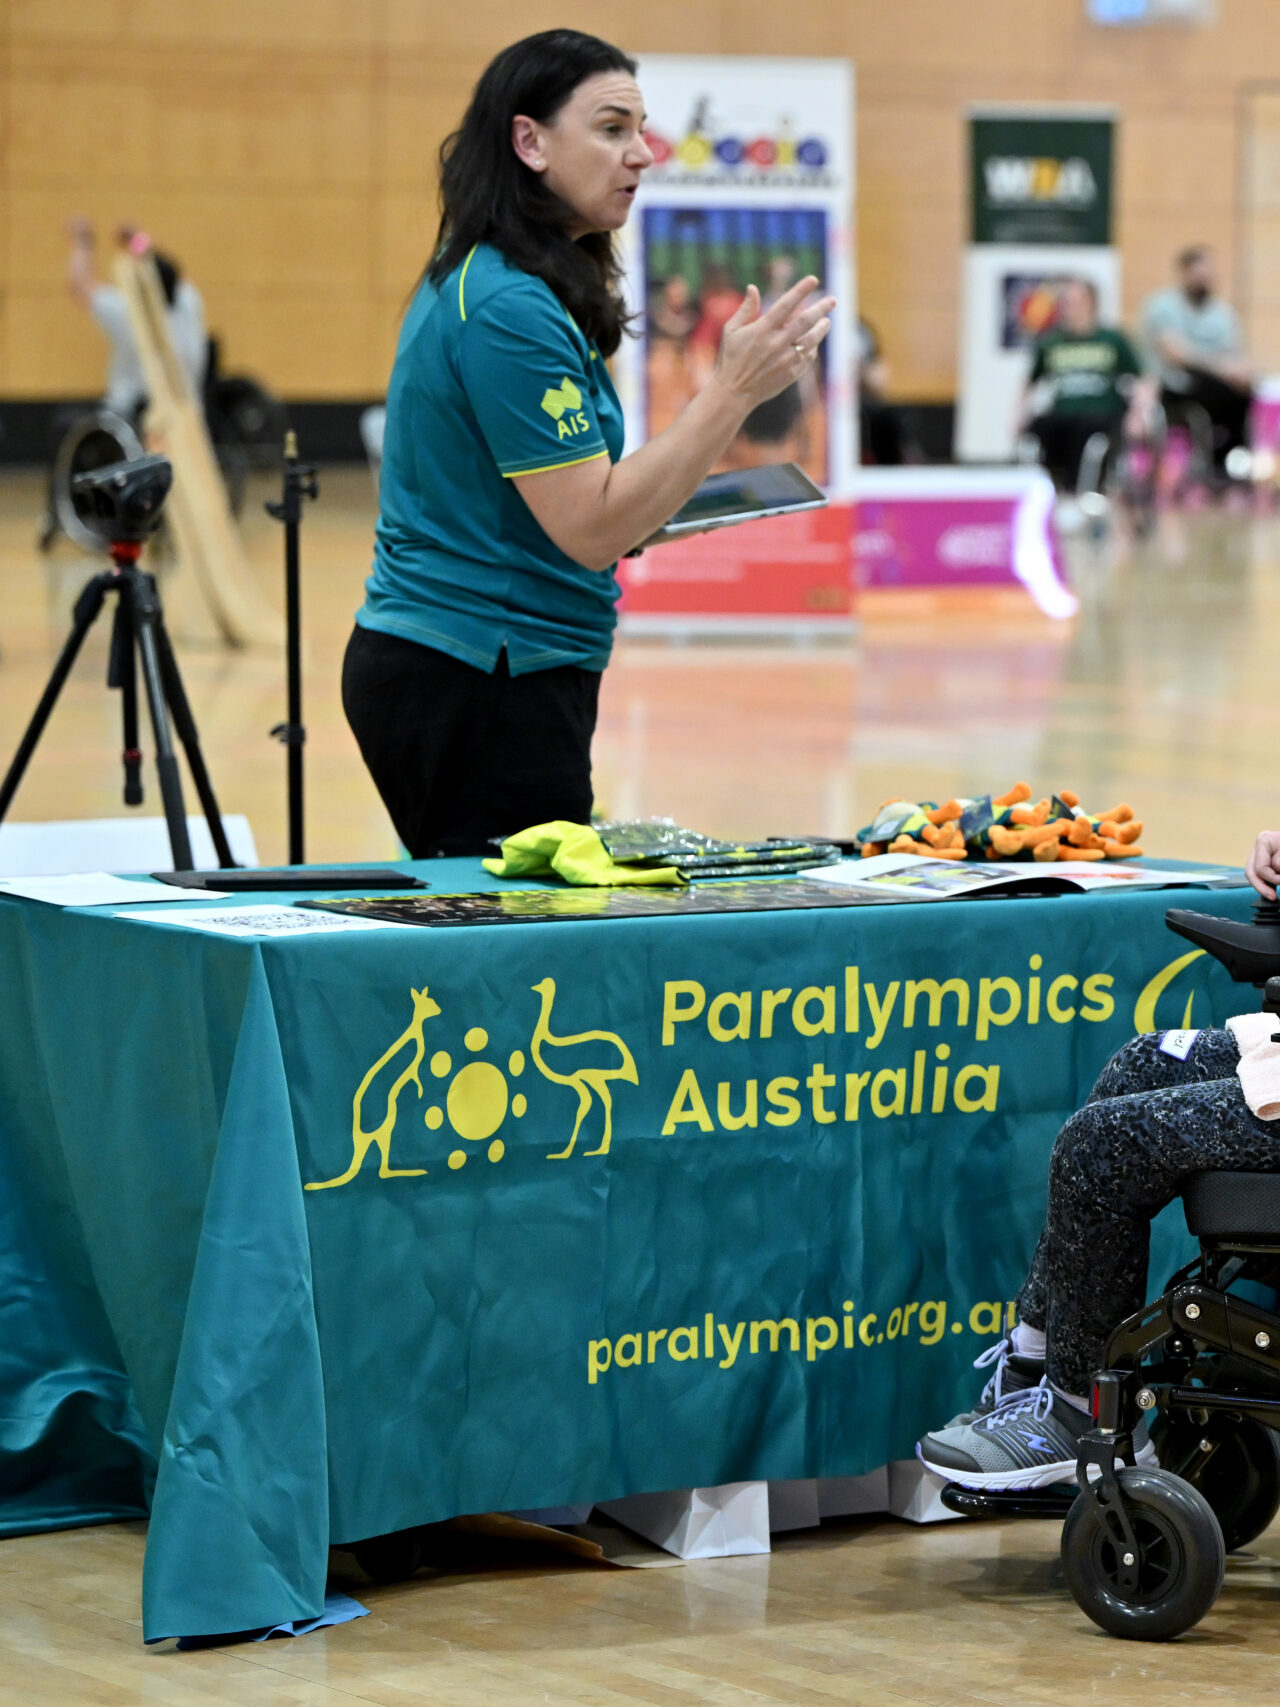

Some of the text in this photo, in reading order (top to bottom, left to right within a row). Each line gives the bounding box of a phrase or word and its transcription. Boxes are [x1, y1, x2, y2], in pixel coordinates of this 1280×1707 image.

[557, 411, 590, 441] AIS
[661, 954, 1115, 1047] Paralympics
[661, 1044, 1001, 1136] Australia
